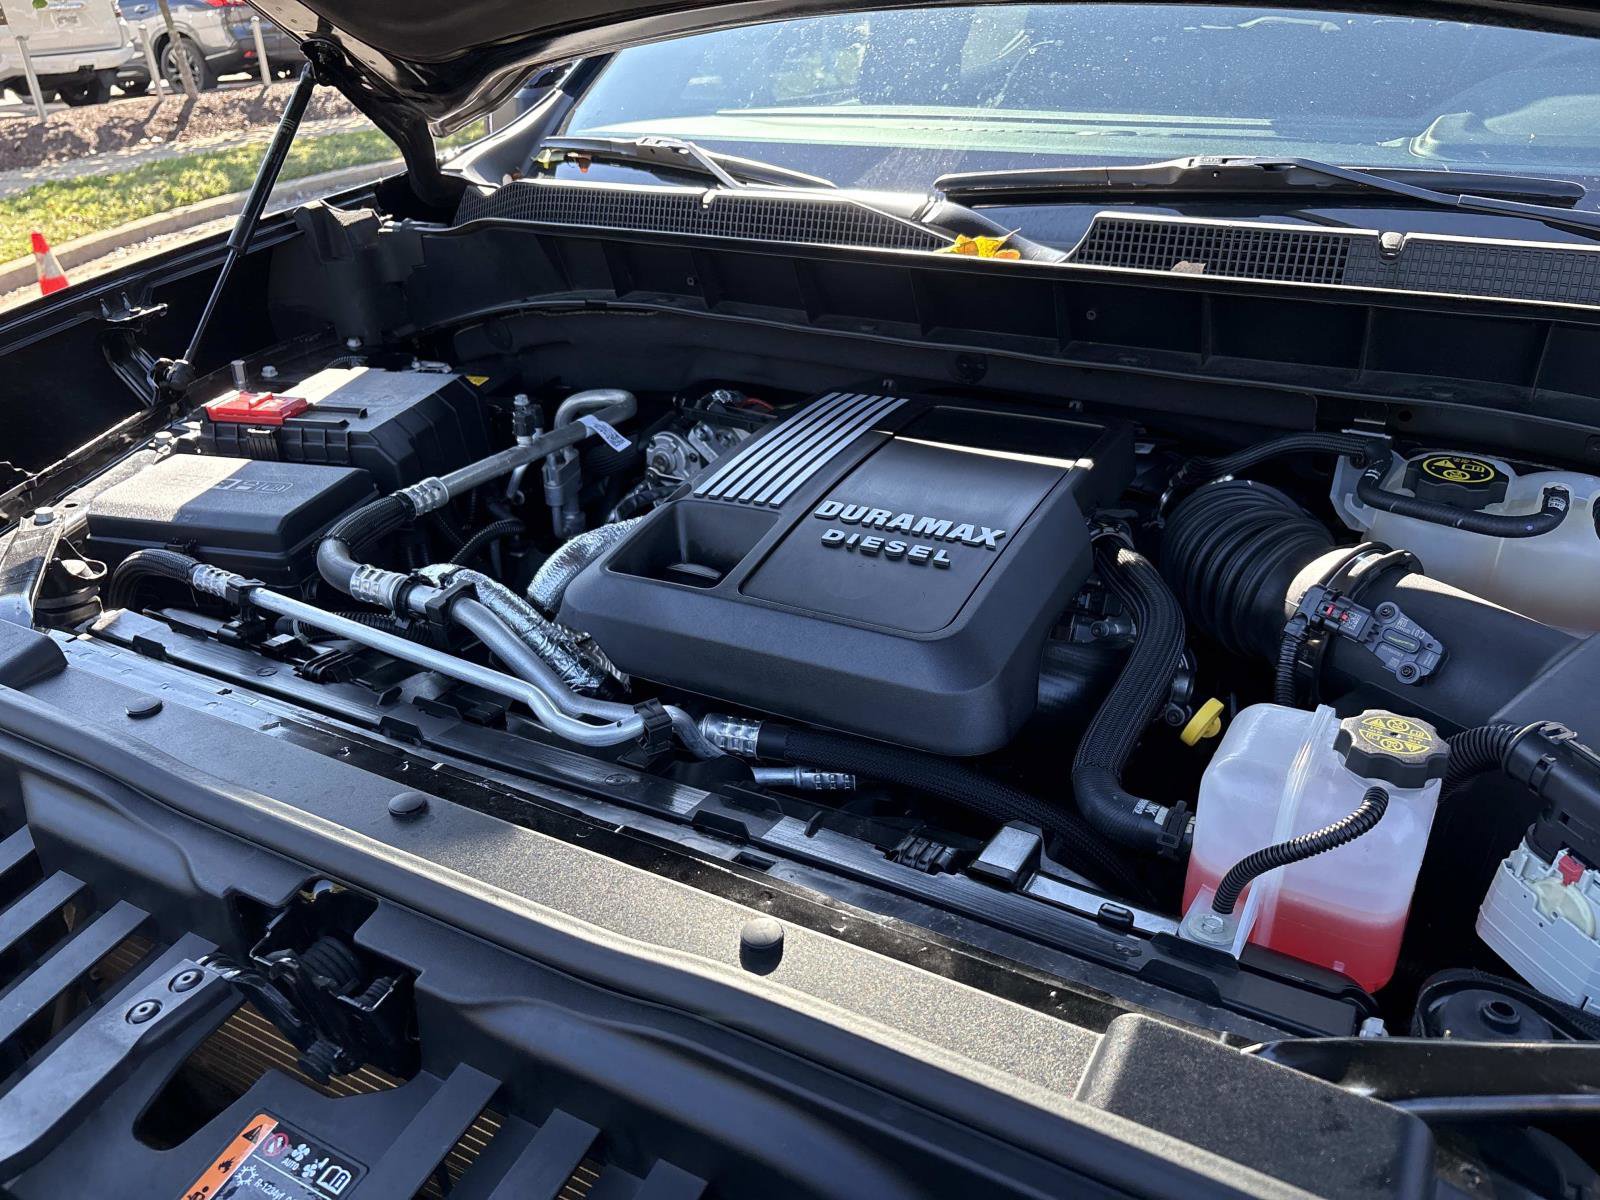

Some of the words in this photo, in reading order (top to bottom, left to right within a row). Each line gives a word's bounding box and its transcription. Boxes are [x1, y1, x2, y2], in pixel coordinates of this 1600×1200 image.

[813, 500, 1006, 550] DURAMAX
[820, 528, 951, 568] DIESEL
[282, 1158, 299, 1170] AUTO
